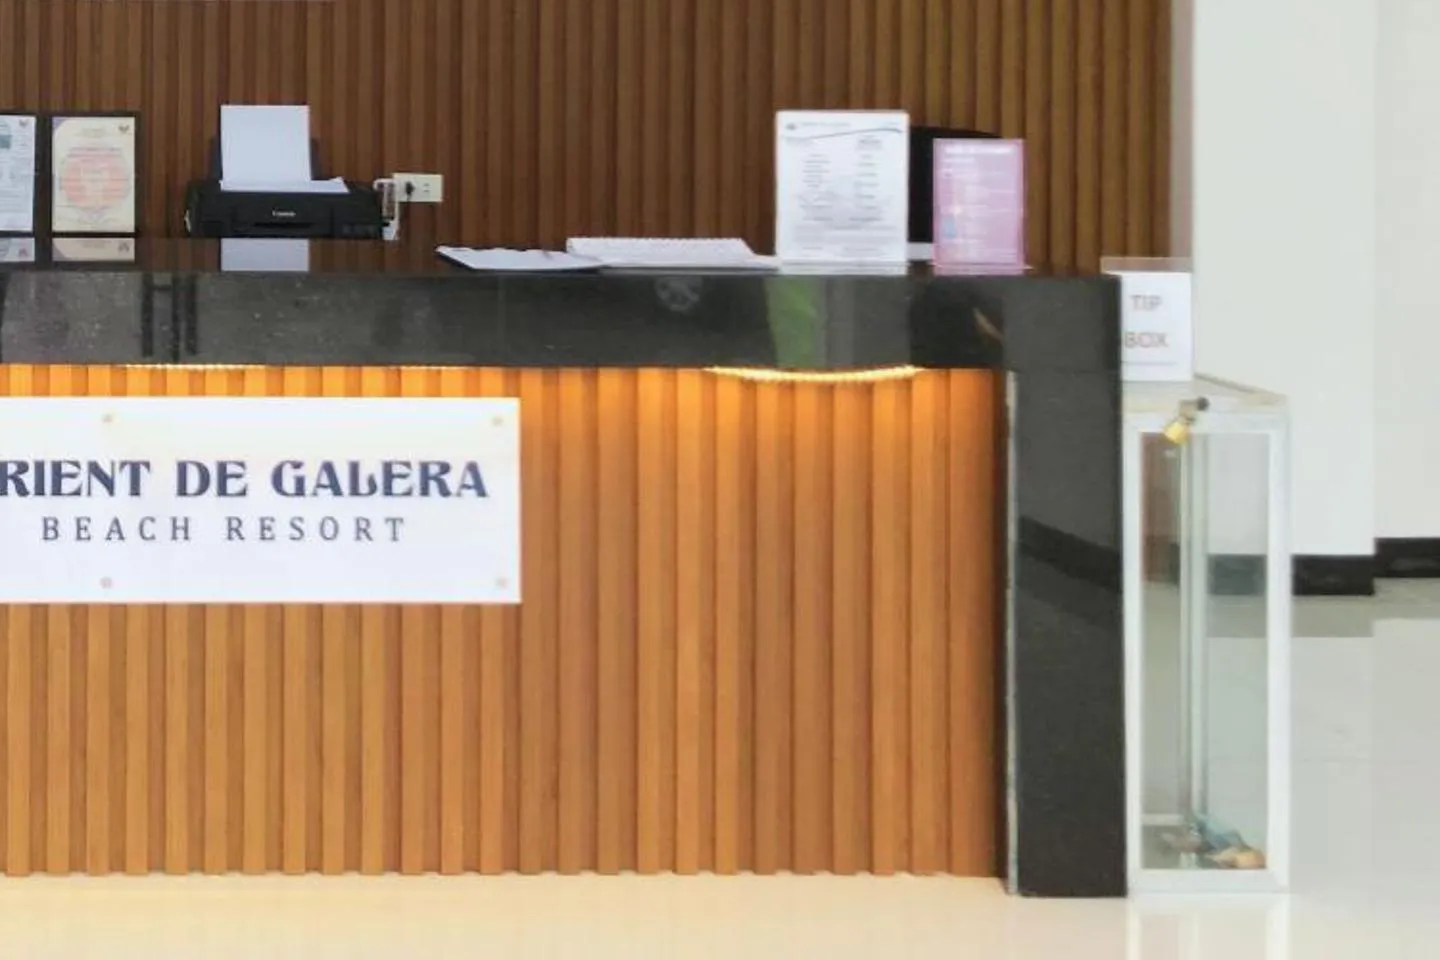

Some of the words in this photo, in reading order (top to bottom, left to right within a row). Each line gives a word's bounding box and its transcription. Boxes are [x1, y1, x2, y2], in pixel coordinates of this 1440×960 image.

[1129, 293, 1162, 311] TIP
[1123, 331, 1169, 349] BOX
[176, 460, 247, 498] DE
[271, 460, 488, 498] GALERA
[42, 516, 192, 542] BEACH
[226, 516, 406, 542] RESORT
